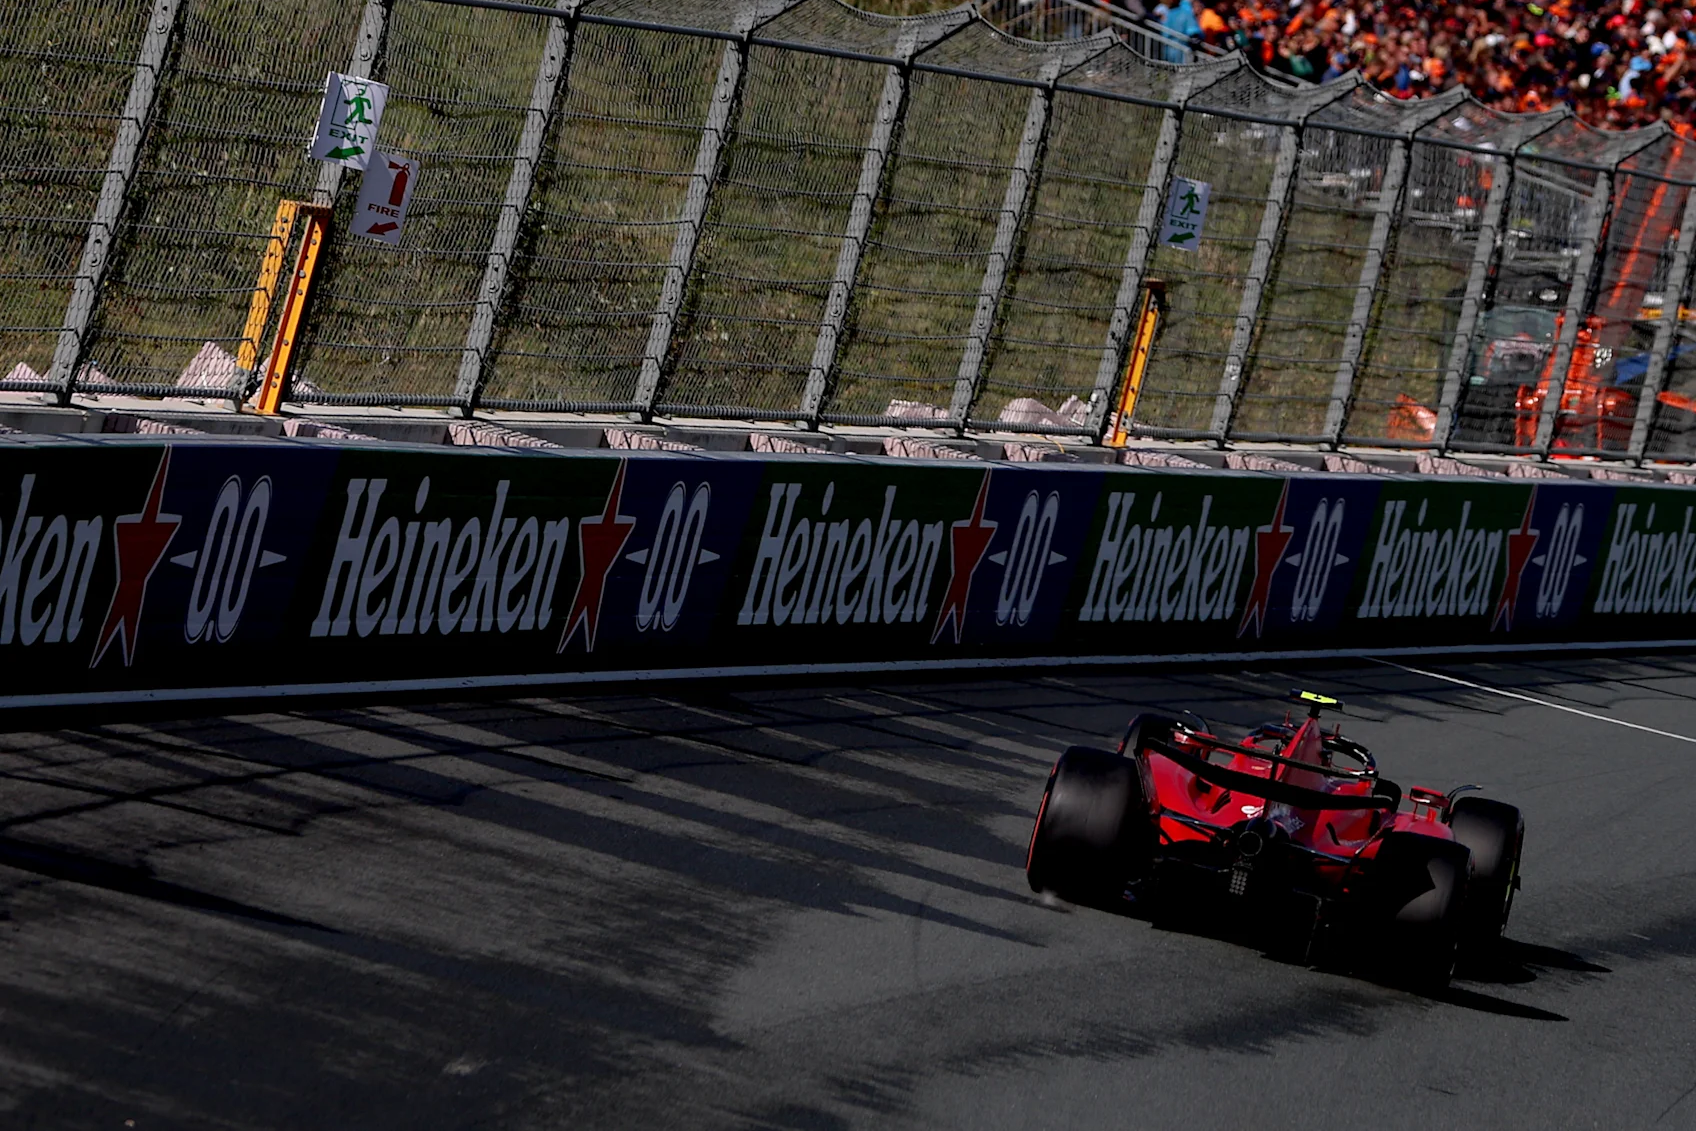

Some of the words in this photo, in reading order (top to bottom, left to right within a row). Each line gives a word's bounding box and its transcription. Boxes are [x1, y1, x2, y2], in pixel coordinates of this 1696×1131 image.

[328, 128, 369, 145] EXIT
[367, 203, 400, 219] FIRE
[1169, 219, 1198, 231] EXIT
[0, 473, 103, 646] ken
[311, 476, 570, 638] Heineken
[737, 481, 944, 626] Heineken
[1079, 491, 1250, 622] Heineken
[1357, 499, 1503, 617] Heineken
